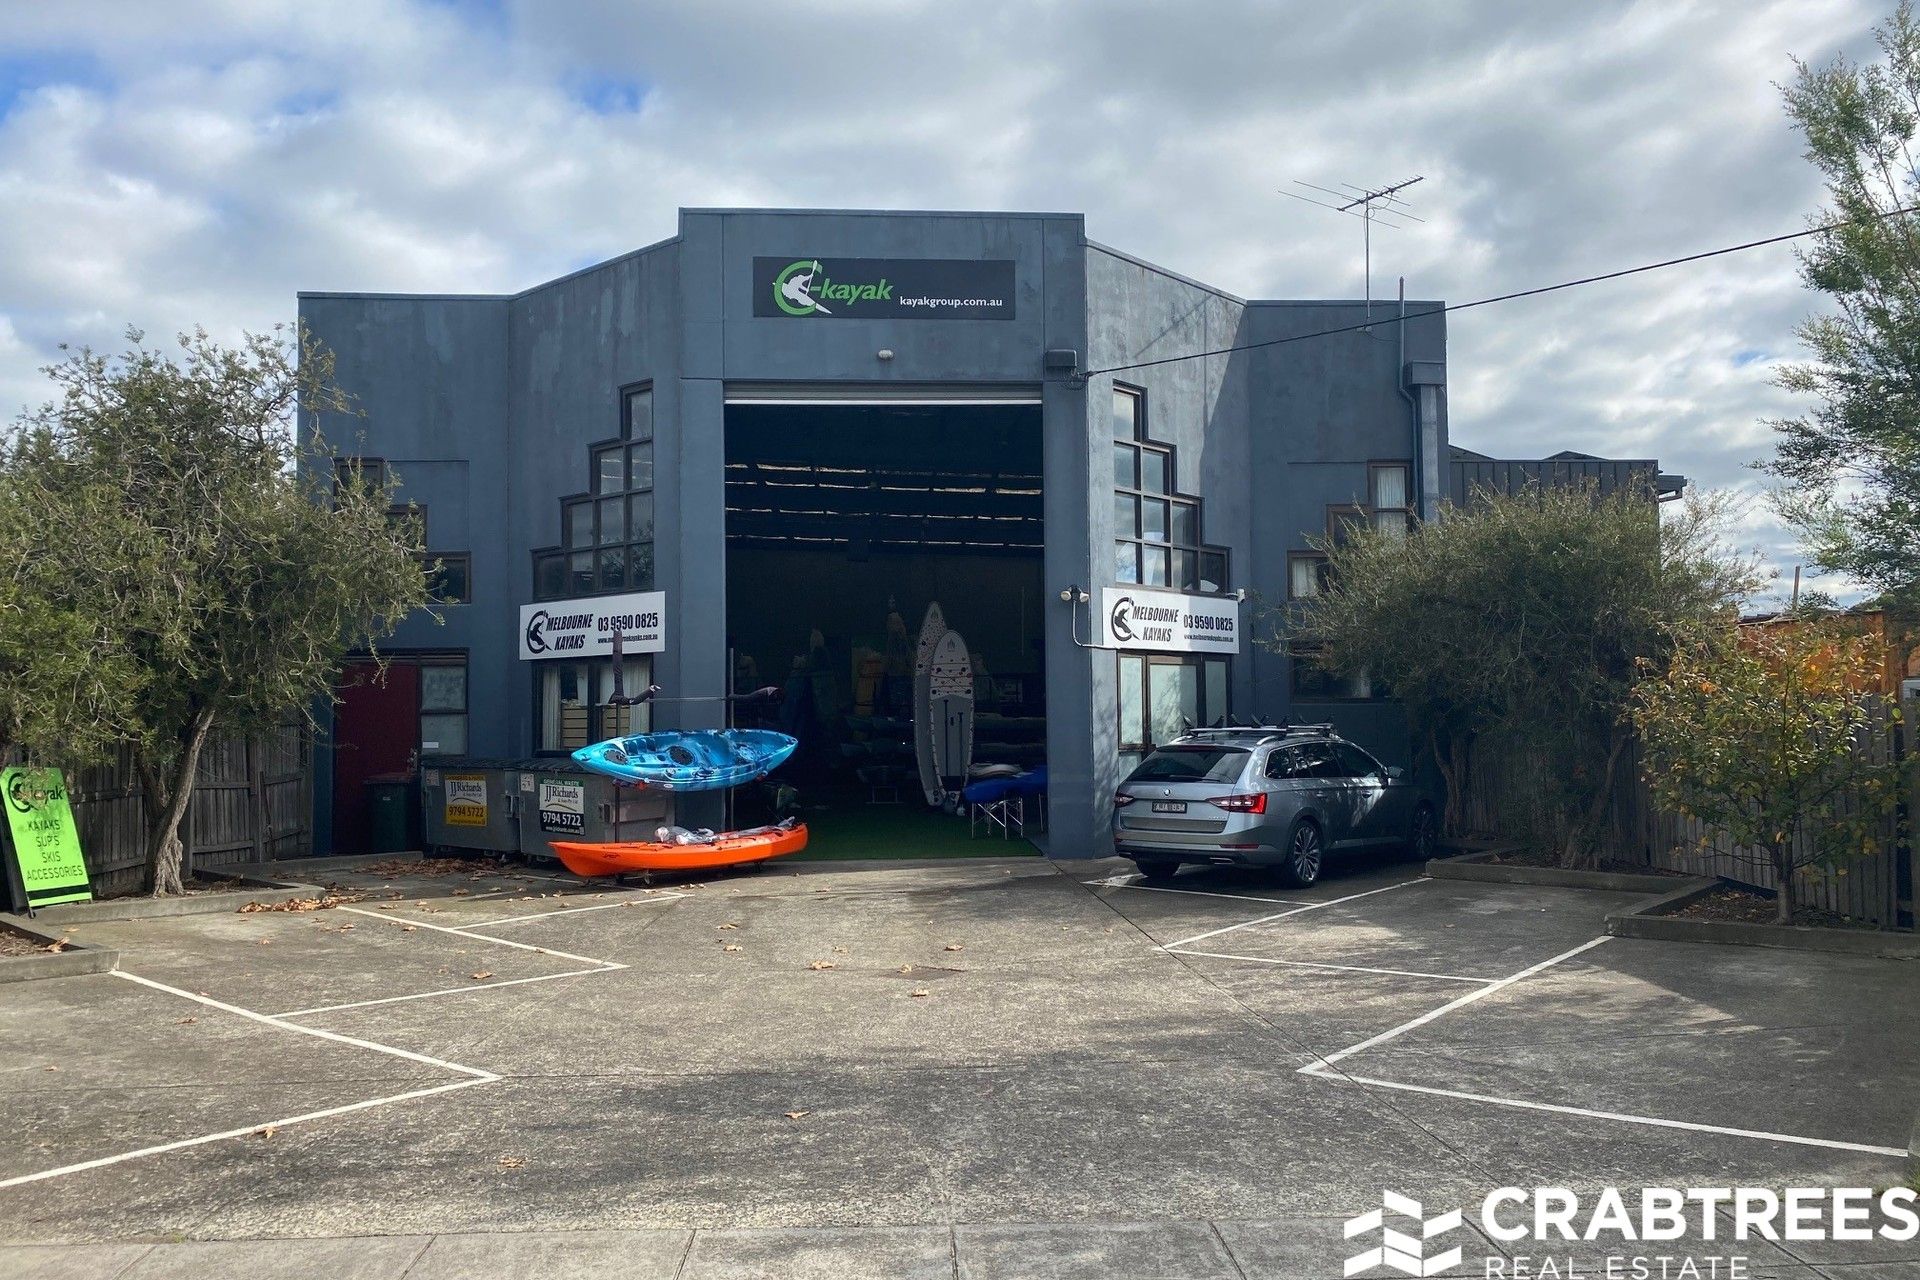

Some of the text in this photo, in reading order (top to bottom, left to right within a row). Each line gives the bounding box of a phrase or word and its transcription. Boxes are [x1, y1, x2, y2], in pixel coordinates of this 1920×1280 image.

[900, 296, 1003, 308] kayakgroup.com.au
[598, 612, 658, 632] 03 9590 0825
[1132, 605, 1179, 623] MELBOURNE
[545, 613, 594, 632] MELBOURNE
[1183, 614, 1234, 632] 03 9590 0825
[1142, 626, 1172, 642] KAYAKS
[554, 634, 586, 651] KAYAKS
[457, 781, 482, 793] Richards
[552, 786, 579, 799] Richards
[449, 805, 484, 818] 9794 5722
[542, 811, 582, 827] 9794 5722
[28, 819, 61, 832] KAYAKS
[41, 851, 61, 864] SKIS
[26, 865, 84, 881] ACCESSORIES
